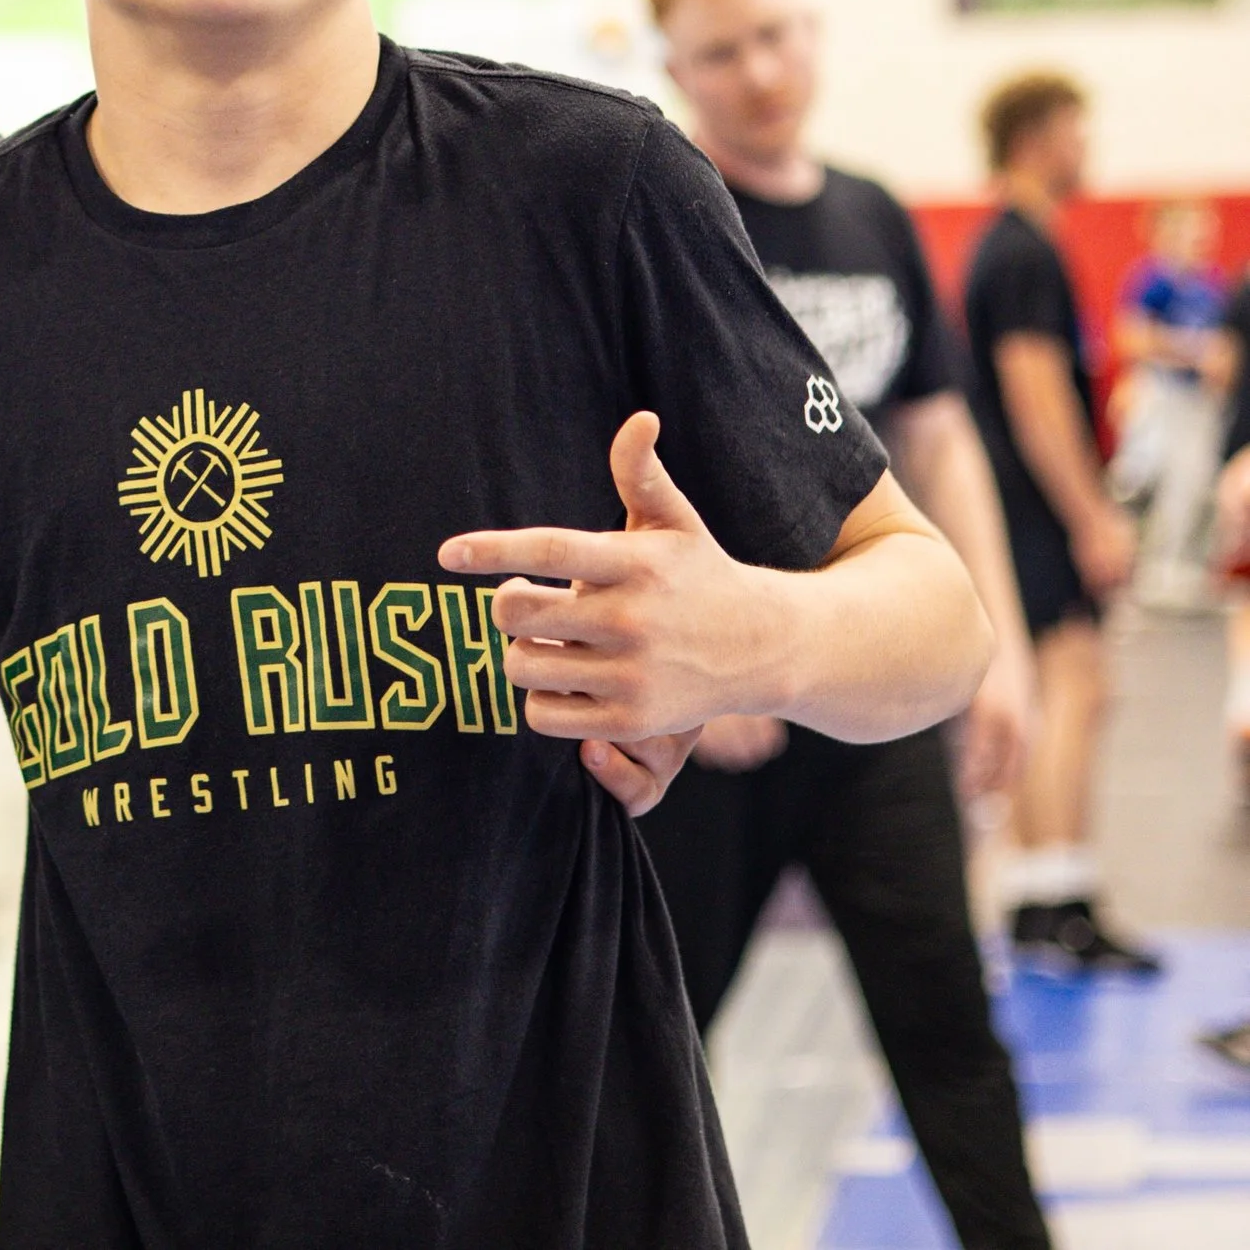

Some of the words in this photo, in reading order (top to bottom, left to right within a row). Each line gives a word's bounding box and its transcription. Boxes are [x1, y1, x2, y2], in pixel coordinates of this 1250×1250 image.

[0, 596, 200, 791] GOLD
[230, 579, 518, 736] RUSH
[82, 754, 398, 827] WRESTLING
